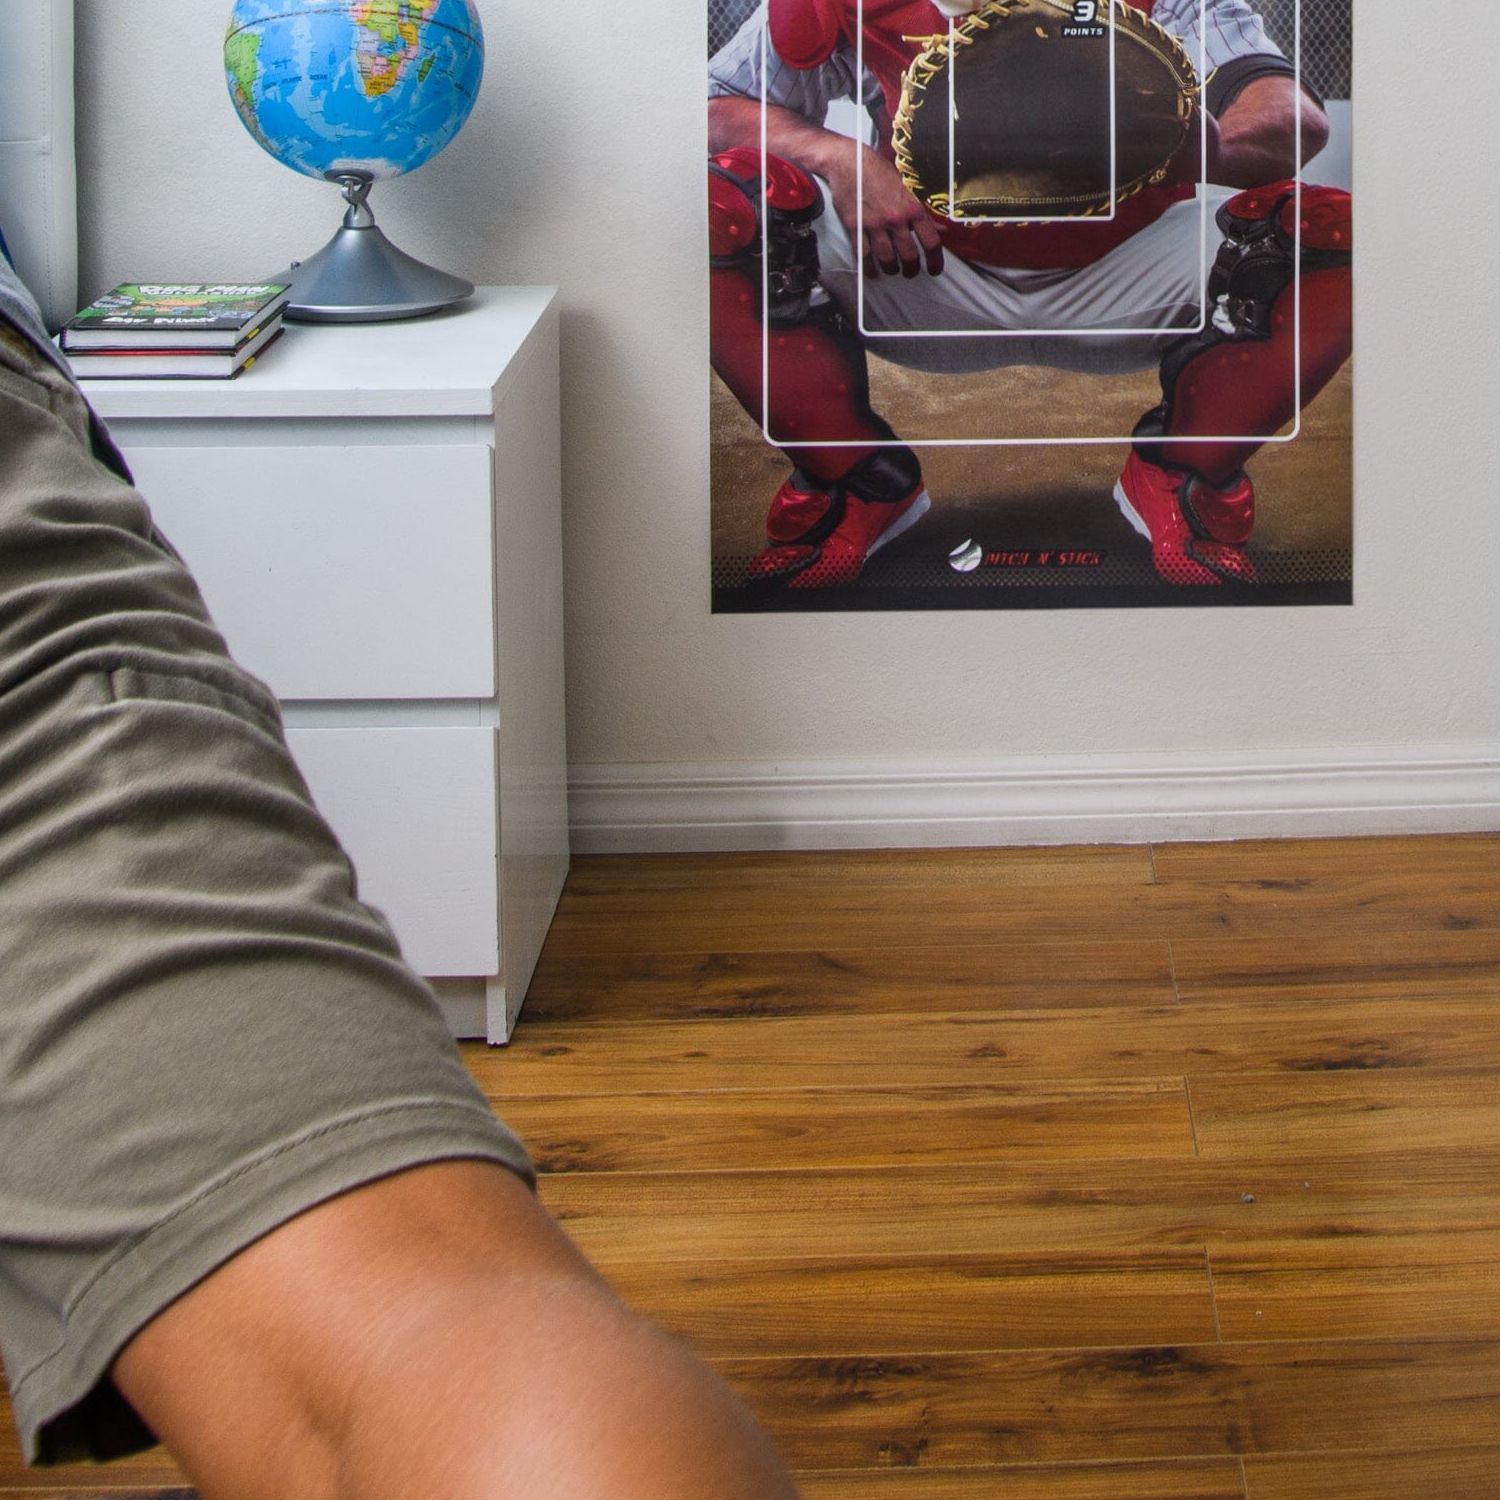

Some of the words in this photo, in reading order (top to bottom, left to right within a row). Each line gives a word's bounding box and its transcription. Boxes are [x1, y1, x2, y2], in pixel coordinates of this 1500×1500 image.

[1073, 0, 1096, 22] 3
[1063, 27, 1104, 36] POINTS
[984, 552, 1030, 565] PITCH
[1059, 552, 1100, 565] STICK
